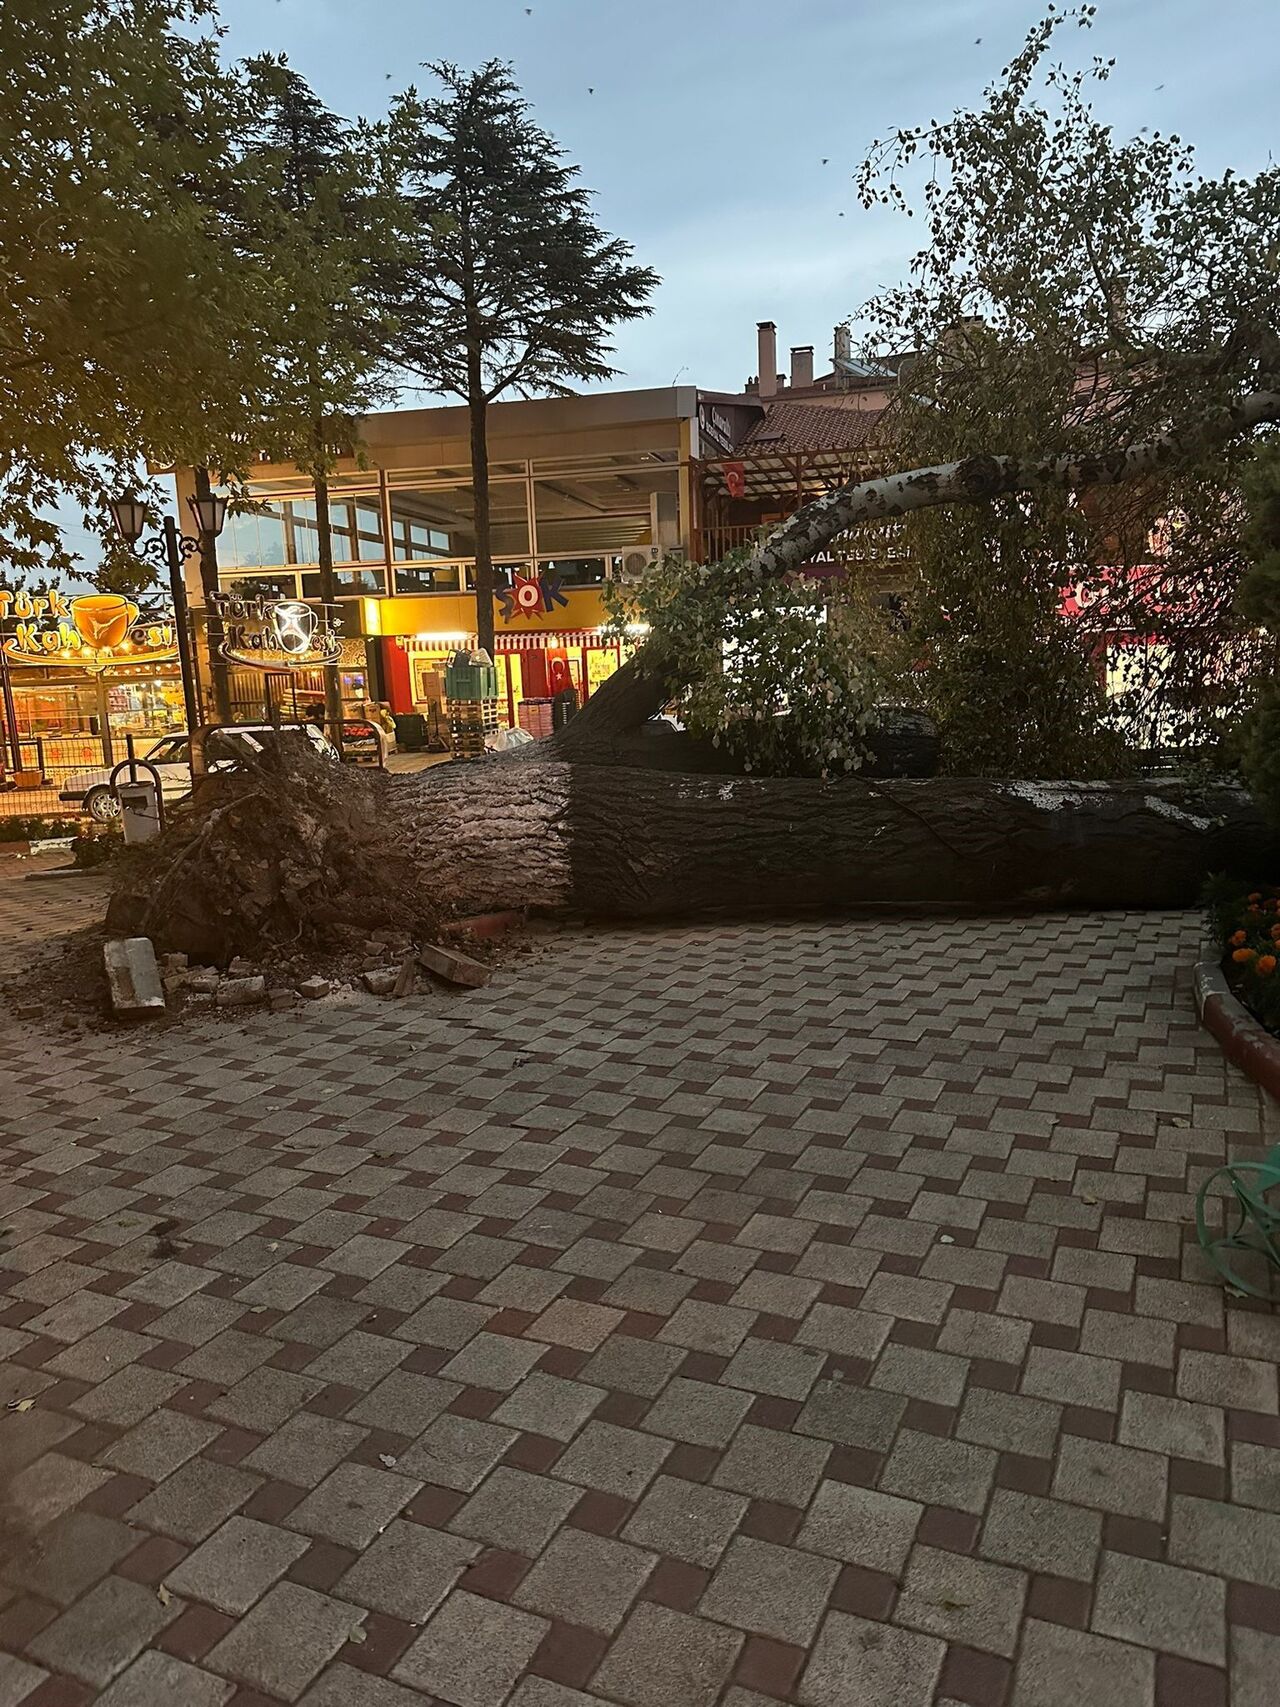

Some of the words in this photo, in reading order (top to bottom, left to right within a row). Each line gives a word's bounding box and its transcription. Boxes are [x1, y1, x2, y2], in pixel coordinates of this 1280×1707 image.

[0, 589, 71, 619] Türk
[209, 590, 277, 620] Türk
[494, 571, 569, 624] ŞOK
[15, 621, 172, 651] Kahesi
[228, 625, 336, 651] Kahesi
